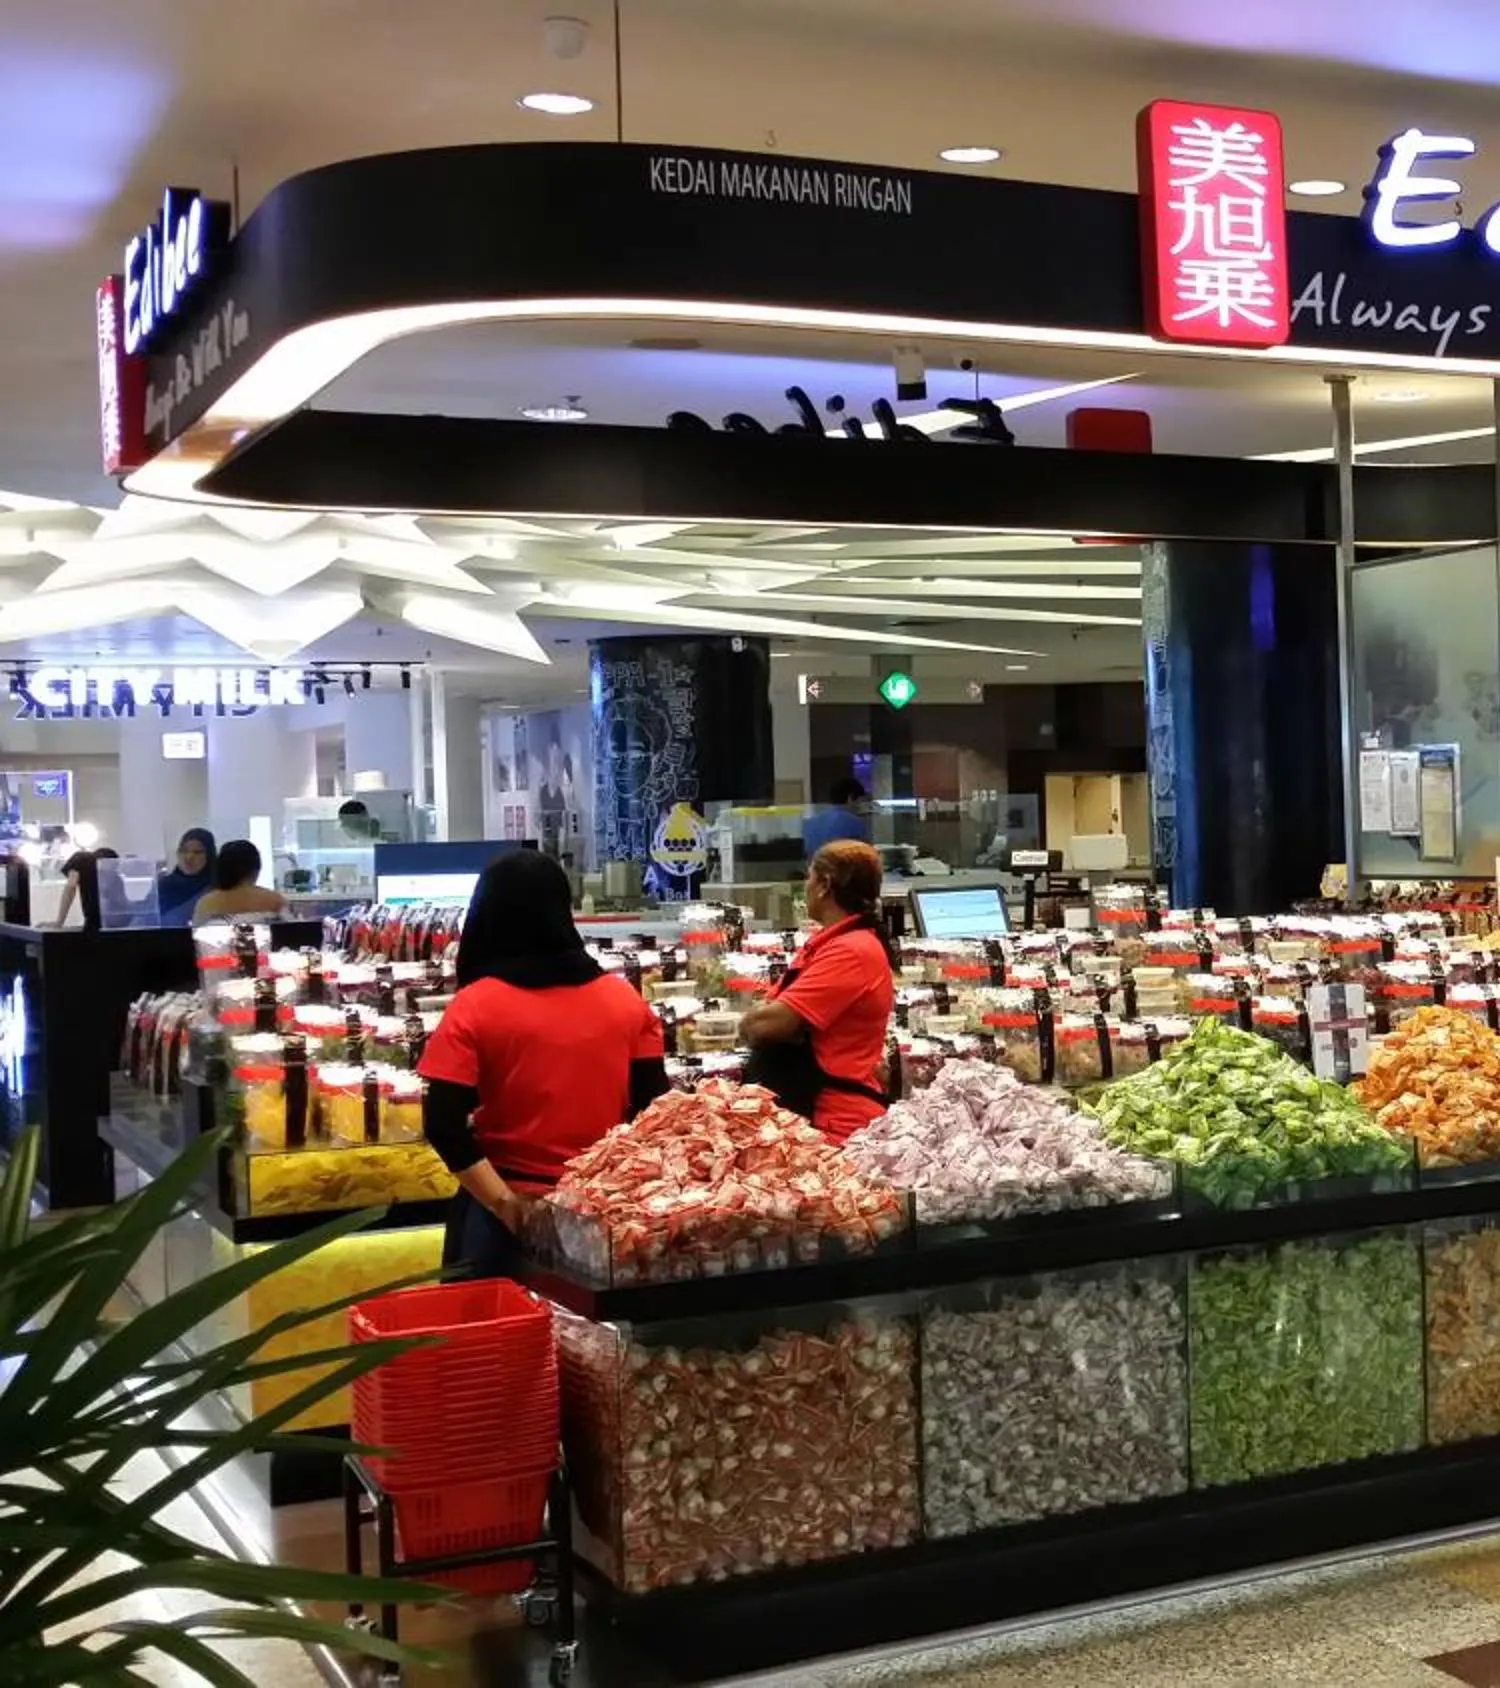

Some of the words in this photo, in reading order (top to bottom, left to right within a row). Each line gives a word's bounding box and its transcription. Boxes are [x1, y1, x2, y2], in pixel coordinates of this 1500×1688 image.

[650, 157, 716, 195] KEDAI
[721, 161, 829, 206] MAKANAN
[834, 172, 913, 215] RINGAN
[1290, 271, 1492, 357] Always
[29, 667, 162, 706] CITY
[173, 667, 305, 705] MILK
